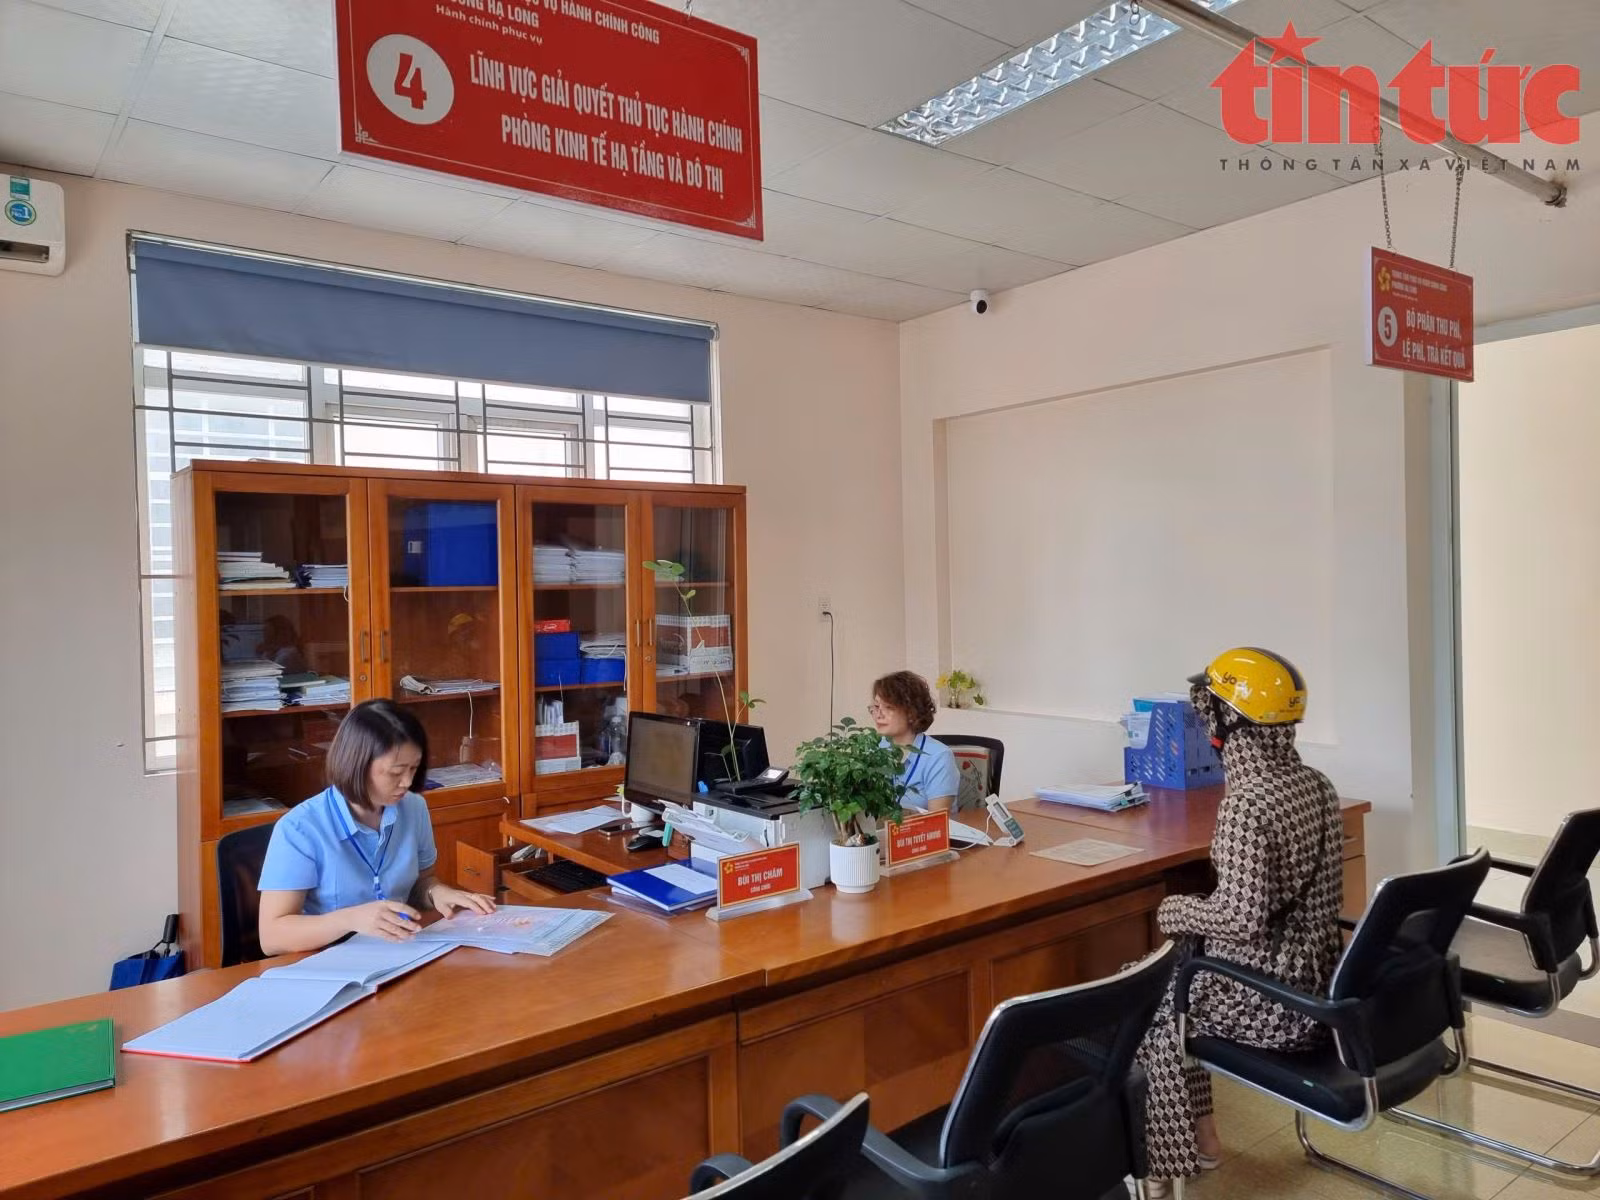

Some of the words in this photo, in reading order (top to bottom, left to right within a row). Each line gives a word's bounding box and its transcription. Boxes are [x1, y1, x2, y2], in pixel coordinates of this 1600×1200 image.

[435, 4, 466, 21] Hành
[468, 15, 499, 31] chính
[501, 25, 527, 39] phục
[529, 34, 543, 46] vụ
[487, 0, 505, 20] HẠ
[507, 4, 540, 28] LONG
[561, 0, 592, 22] HÀNH
[595, 10, 628, 35] CHÍNH
[631, 21, 660, 44] CÔNG
[394, 52, 428, 111] 4
[470, 50, 505, 92] LĨNH
[508, 64, 538, 104] VỰC
[541, 68, 570, 109] GIẢI
[573, 82, 614, 121] QUYẾT
[617, 90, 643, 128] THỦ
[645, 102, 669, 138] TỤC
[671, 106, 705, 144] HÀNH
[707, 118, 743, 155] CHÍNH
[501, 112, 552, 154] PHÒNG
[554, 126, 589, 163] KINH
[591, 130, 609, 168] TẾ
[610, 140, 629, 177] HẠ
[667, 151, 684, 185] VÀ
[686, 156, 702, 189] ĐÔ
[704, 164, 725, 200] THỊ
[1383, 314, 1393, 341] 5
